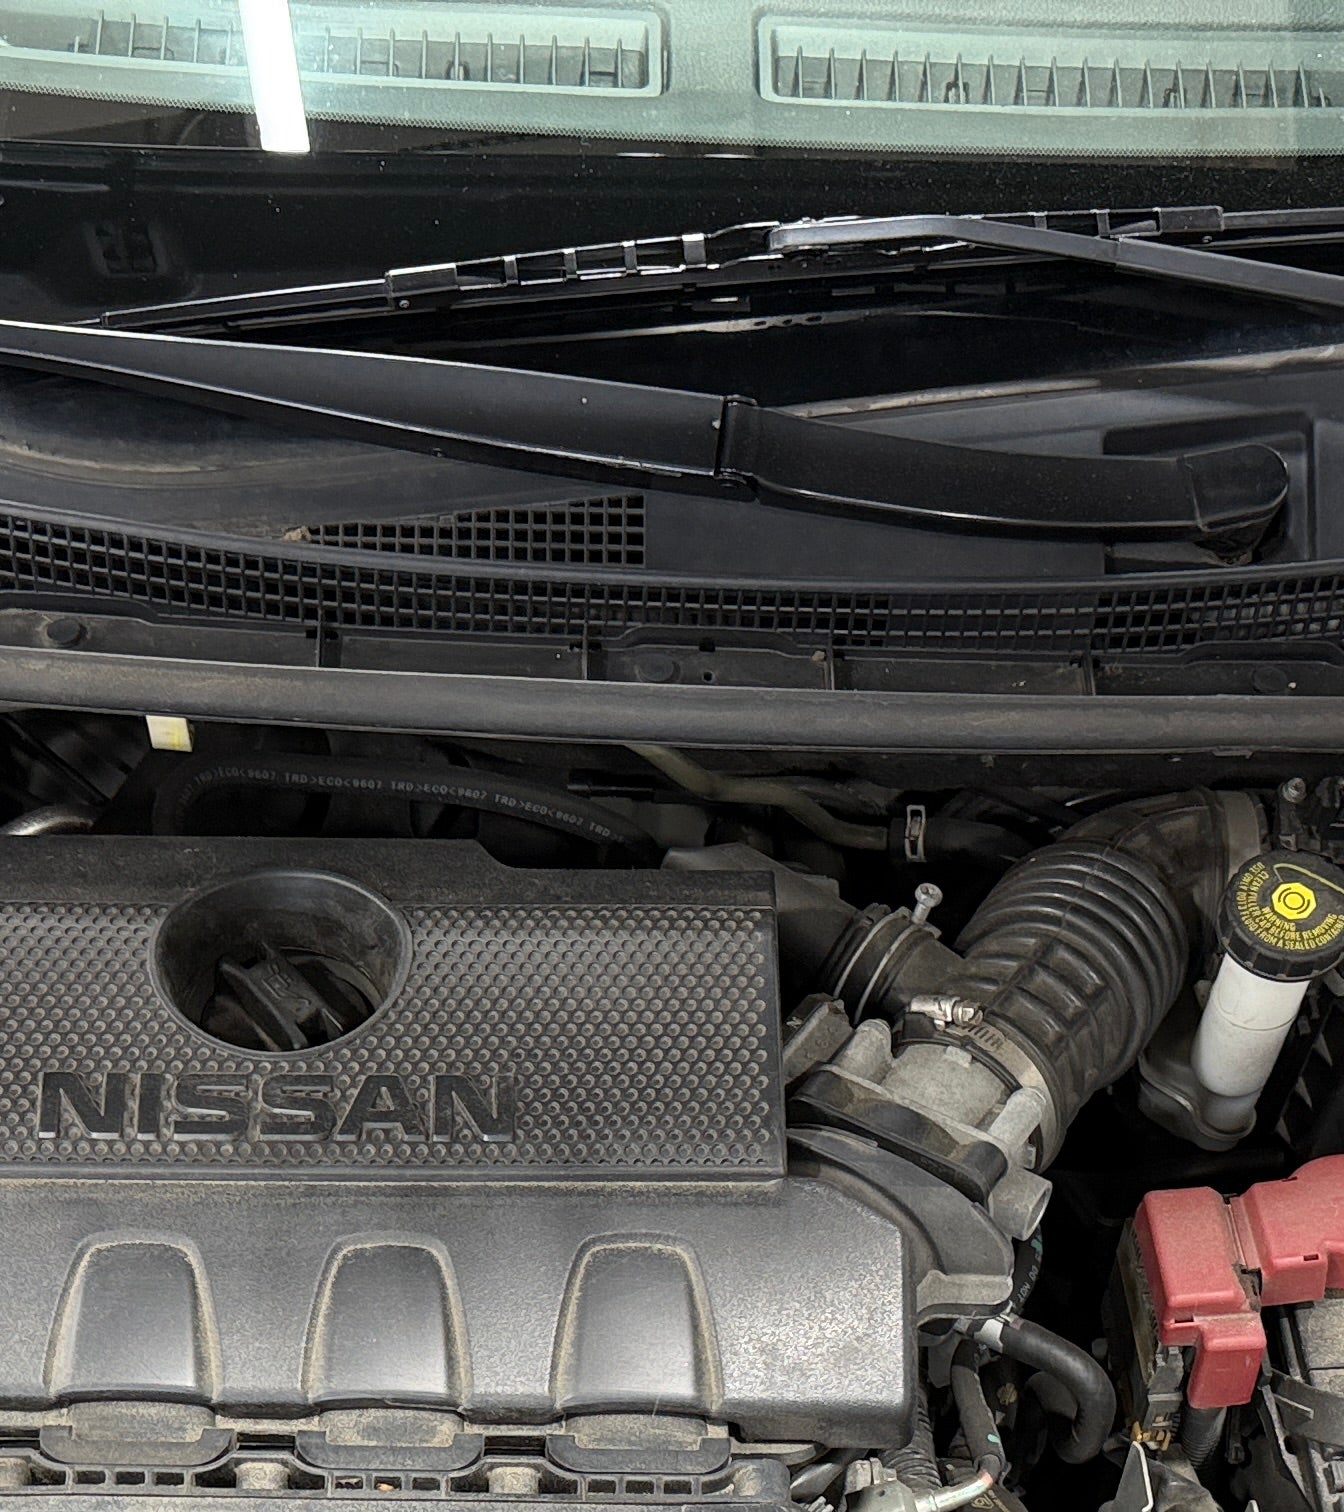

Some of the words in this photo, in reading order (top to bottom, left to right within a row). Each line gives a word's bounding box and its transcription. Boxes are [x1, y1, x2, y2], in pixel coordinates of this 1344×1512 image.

[1255, 915, 1272, 931] CAP
[1268, 926, 1303, 941] BEFORE
[1302, 912, 1338, 941] REMOVING
[1261, 906, 1297, 931] WARNING
[1254, 929, 1278, 946] FROM
[1276, 938, 1284, 948] A
[1285, 939, 1316, 951] SEALED
[37, 1071, 514, 1142] NISSAN
